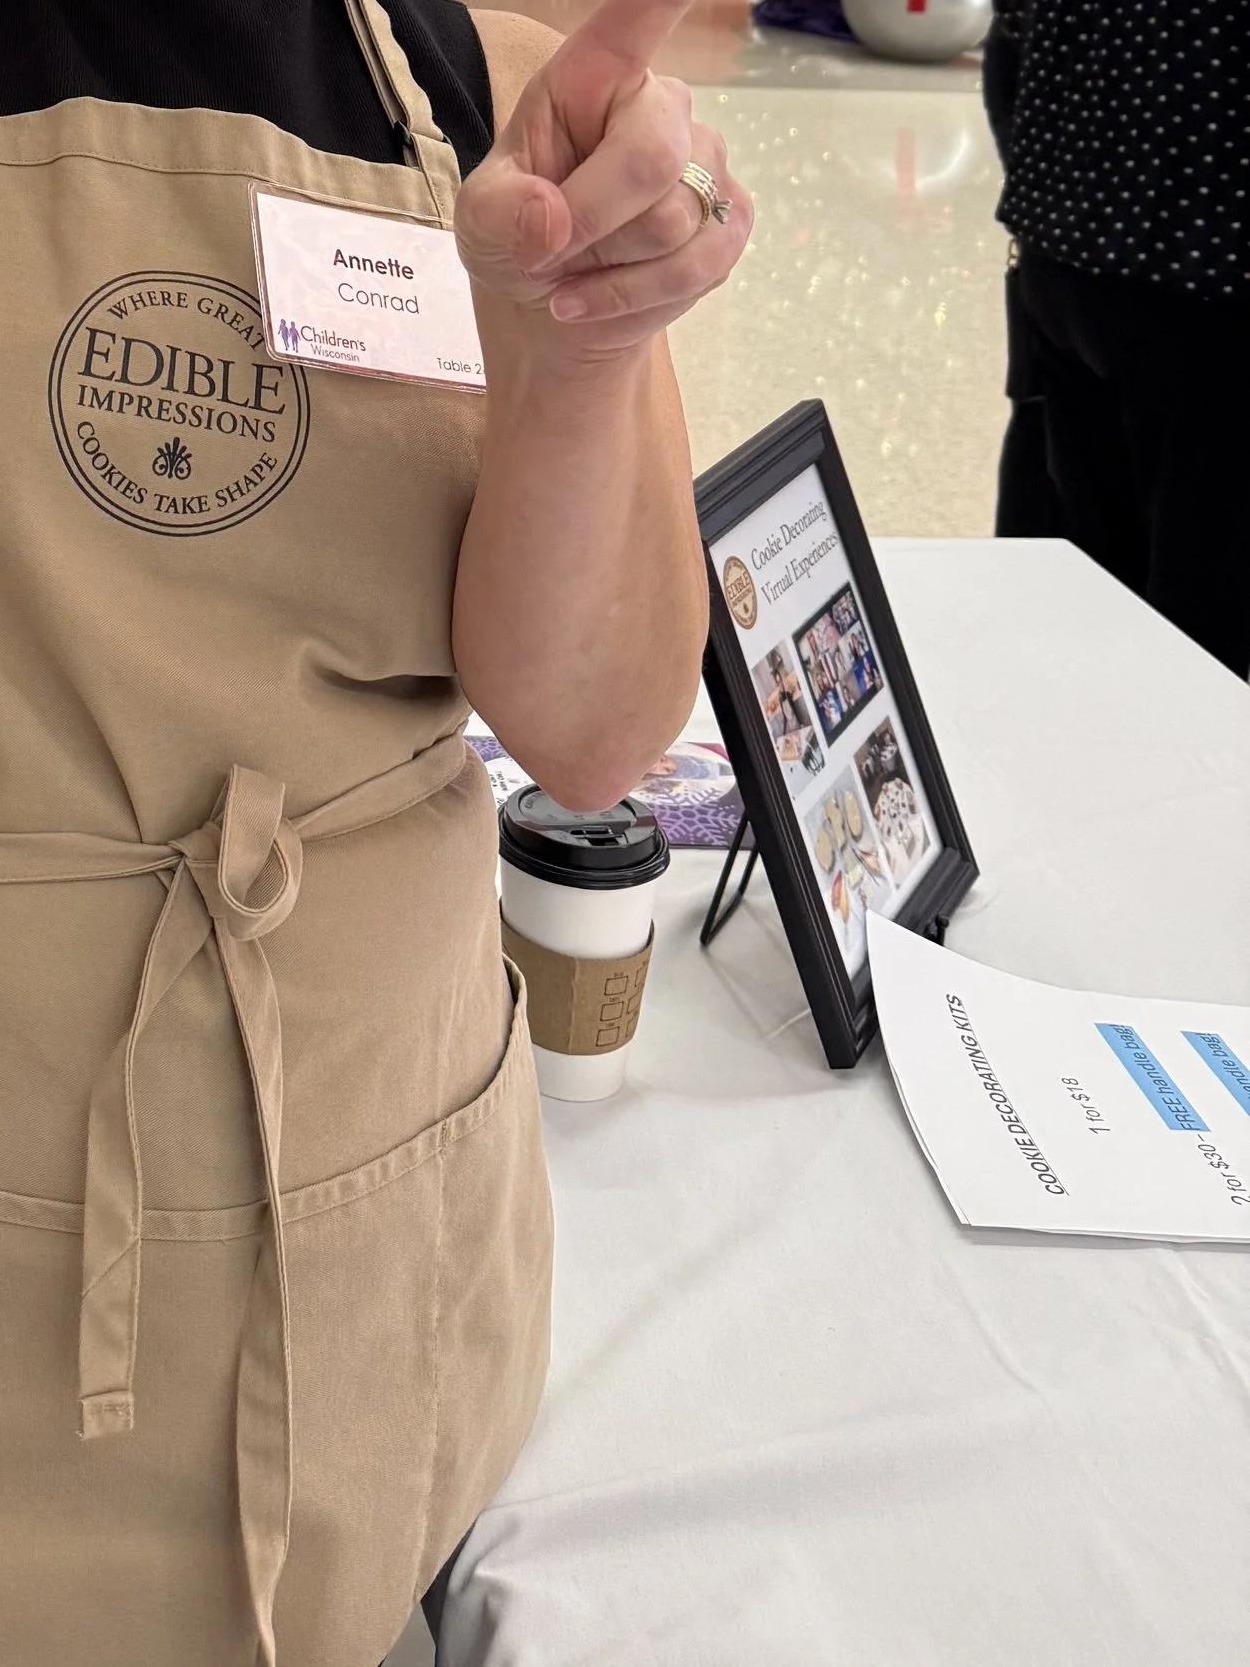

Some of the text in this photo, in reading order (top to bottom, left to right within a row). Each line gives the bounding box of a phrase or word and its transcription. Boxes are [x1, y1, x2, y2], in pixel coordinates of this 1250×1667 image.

[333, 249, 415, 280] Annette
[337, 282, 420, 314] Conrad
[106, 290, 266, 352] WHERE GREAT
[300, 325, 367, 352] Children's
[310, 343, 360, 363] Wisconsin
[76, 326, 287, 416] EDIBLE
[436, 357, 471, 373] Table
[77, 384, 276, 444] IMPRESSIONS
[77, 420, 278, 515] COOKIES TAKE SHAPE
[751, 501, 827, 570] Cookie Decorating
[1109, 1022, 1141, 1050] bag!
[1194, 1032, 1229, 1058] bag!
[1133, 1052, 1175, 1095] handle
[946, 994, 1065, 1195] COOKIE DECORATING KITS
[1061, 1077, 1091, 1102] $18
[1081, 1103, 1104, 1122] for
[1161, 1096, 1200, 1131] FREE
[1219, 1172, 1247, 1192] for
[1230, 1195, 1250, 1206] 2
